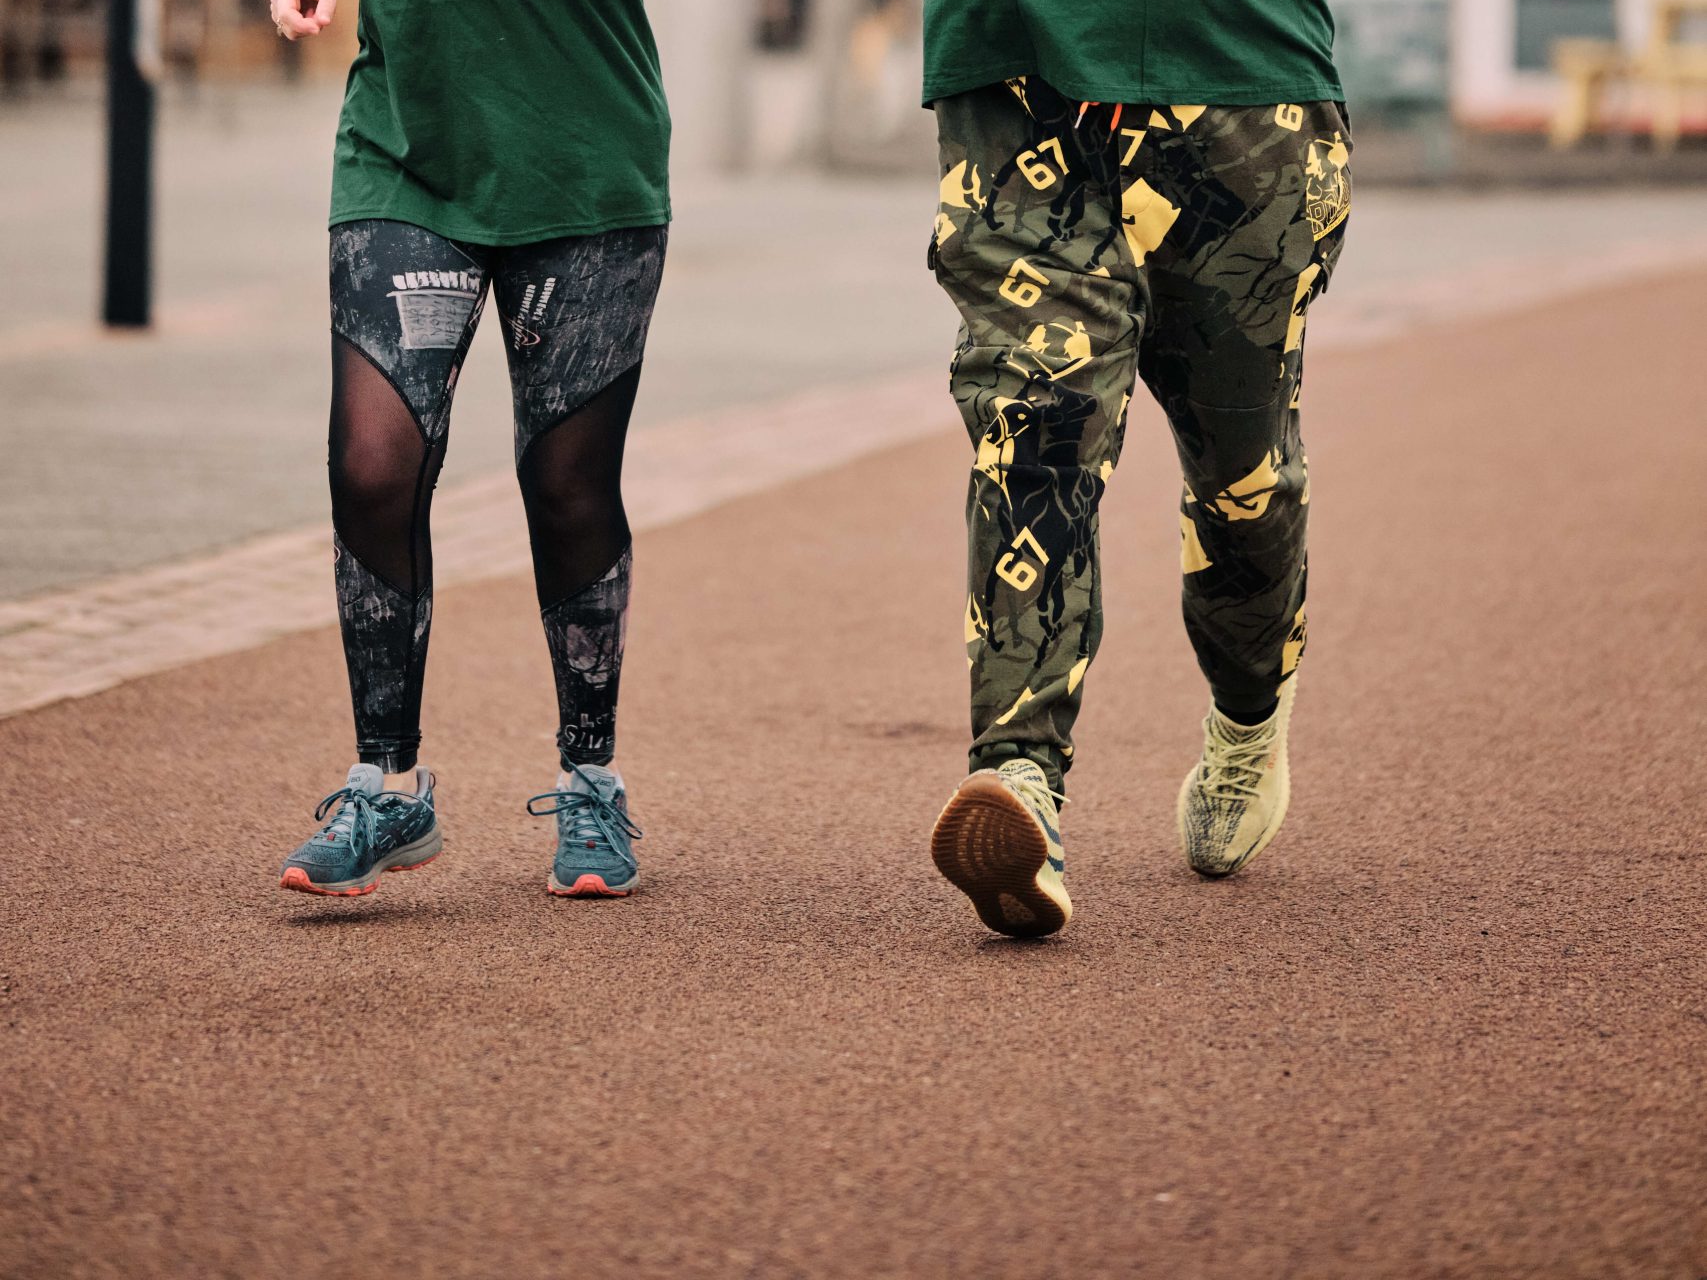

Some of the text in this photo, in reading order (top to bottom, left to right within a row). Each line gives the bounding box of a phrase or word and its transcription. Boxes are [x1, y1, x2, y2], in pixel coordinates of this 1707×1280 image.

[1016, 136, 1070, 191] 67
[1120, 128, 1147, 167] 7
[998, 257, 1051, 308] 67
[995, 525, 1051, 592] 67
